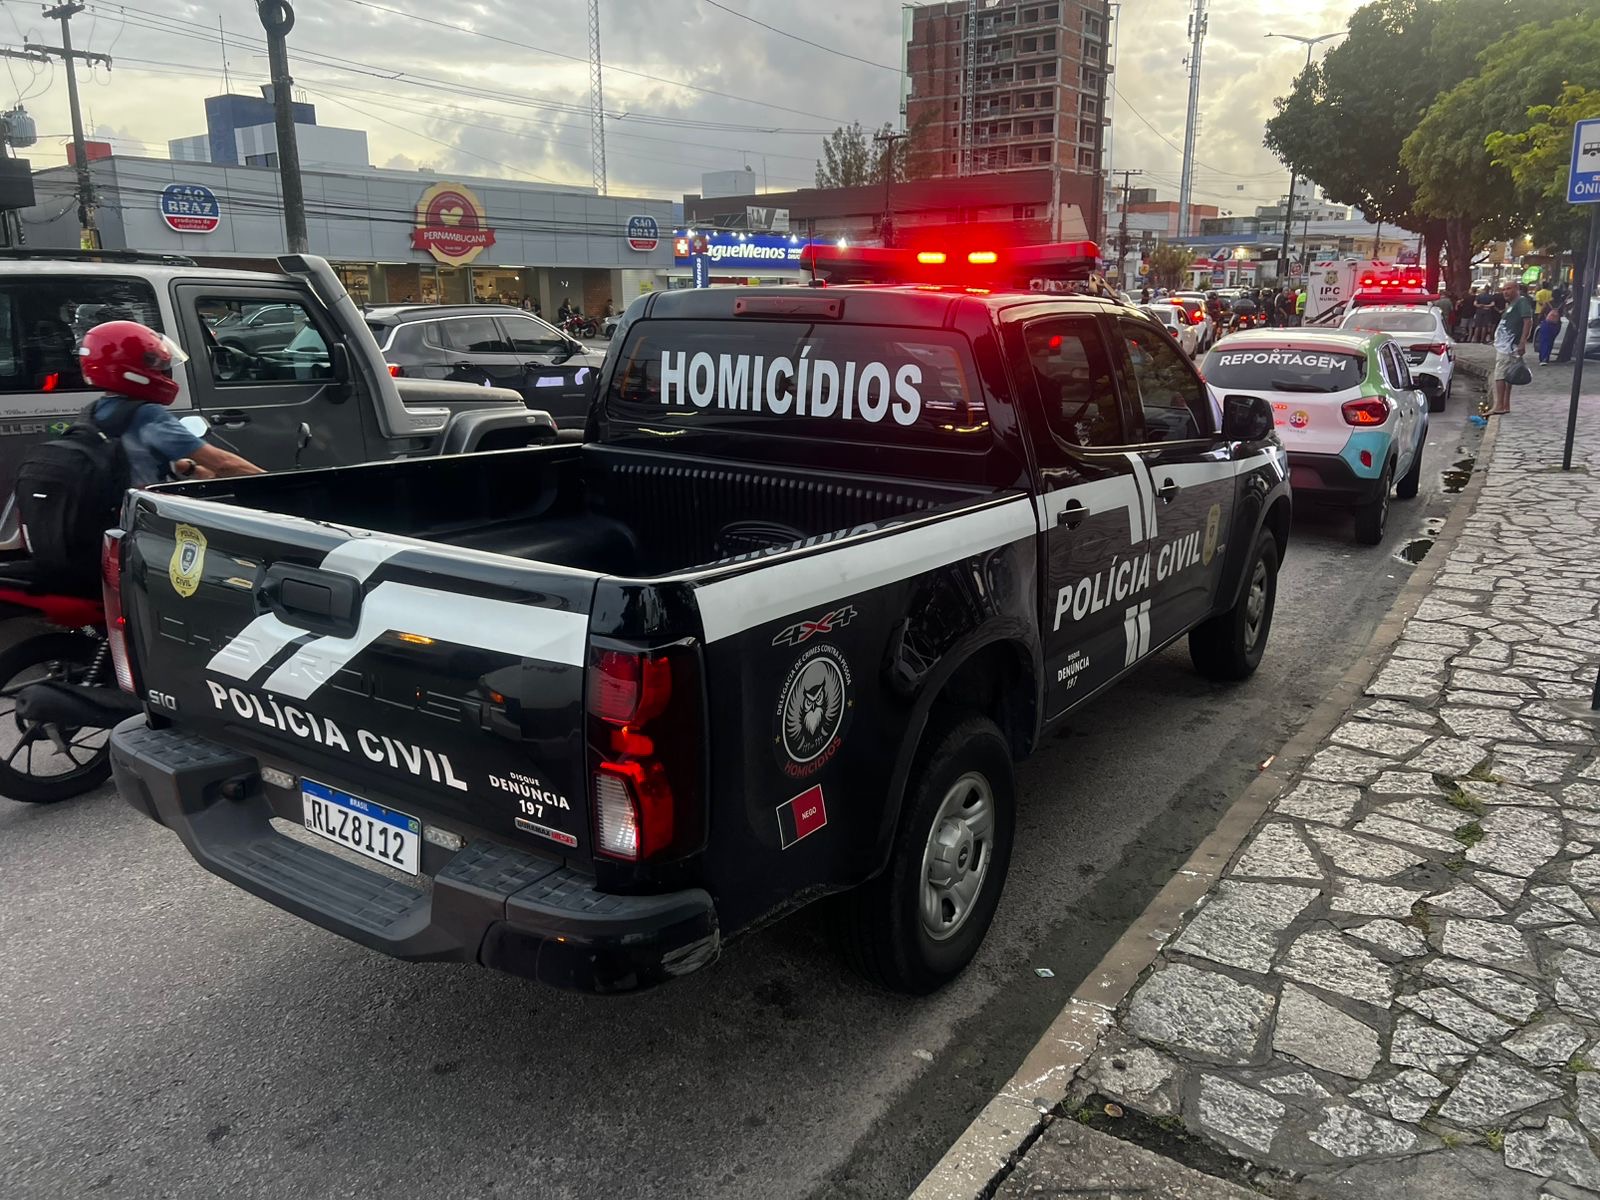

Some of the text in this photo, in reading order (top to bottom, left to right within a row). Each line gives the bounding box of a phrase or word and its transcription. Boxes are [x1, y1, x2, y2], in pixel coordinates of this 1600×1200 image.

[1575, 181, 1600, 195] ÔNI
[168, 201, 213, 215] BRAZ
[423, 231, 487, 243] PERNAMBUCANA
[707, 243, 786, 261] agueMenos
[1320, 286, 1341, 295] IPC
[1219, 353, 1347, 371] REPORTAGEM
[660, 346, 922, 426] HOMICÍDIOS
[0, 423, 46, 435] LLER
[175, 577, 192, 587] CIVIL
[1053, 530, 1200, 632] POLÍCIA CIVIL
[1057, 656, 1090, 682] DENÚNCIA
[776, 669, 796, 715] DELEGACIA
[794, 658, 803, 670] DE
[802, 645, 821, 662] CRIMES
[820, 644, 839, 659] CONTRA
[840, 658, 852, 686] PESSOA
[149, 690, 176, 711] S10
[206, 680, 468, 791] POLÍCIA CIVIL
[509, 771, 541, 787] DISQUE
[488, 774, 571, 811] DENÚNCIA
[349, 797, 369, 812] BRASIL
[519, 799, 544, 818] 197
[801, 806, 817, 820] NEGO
[311, 799, 404, 865] RLZ8I12
